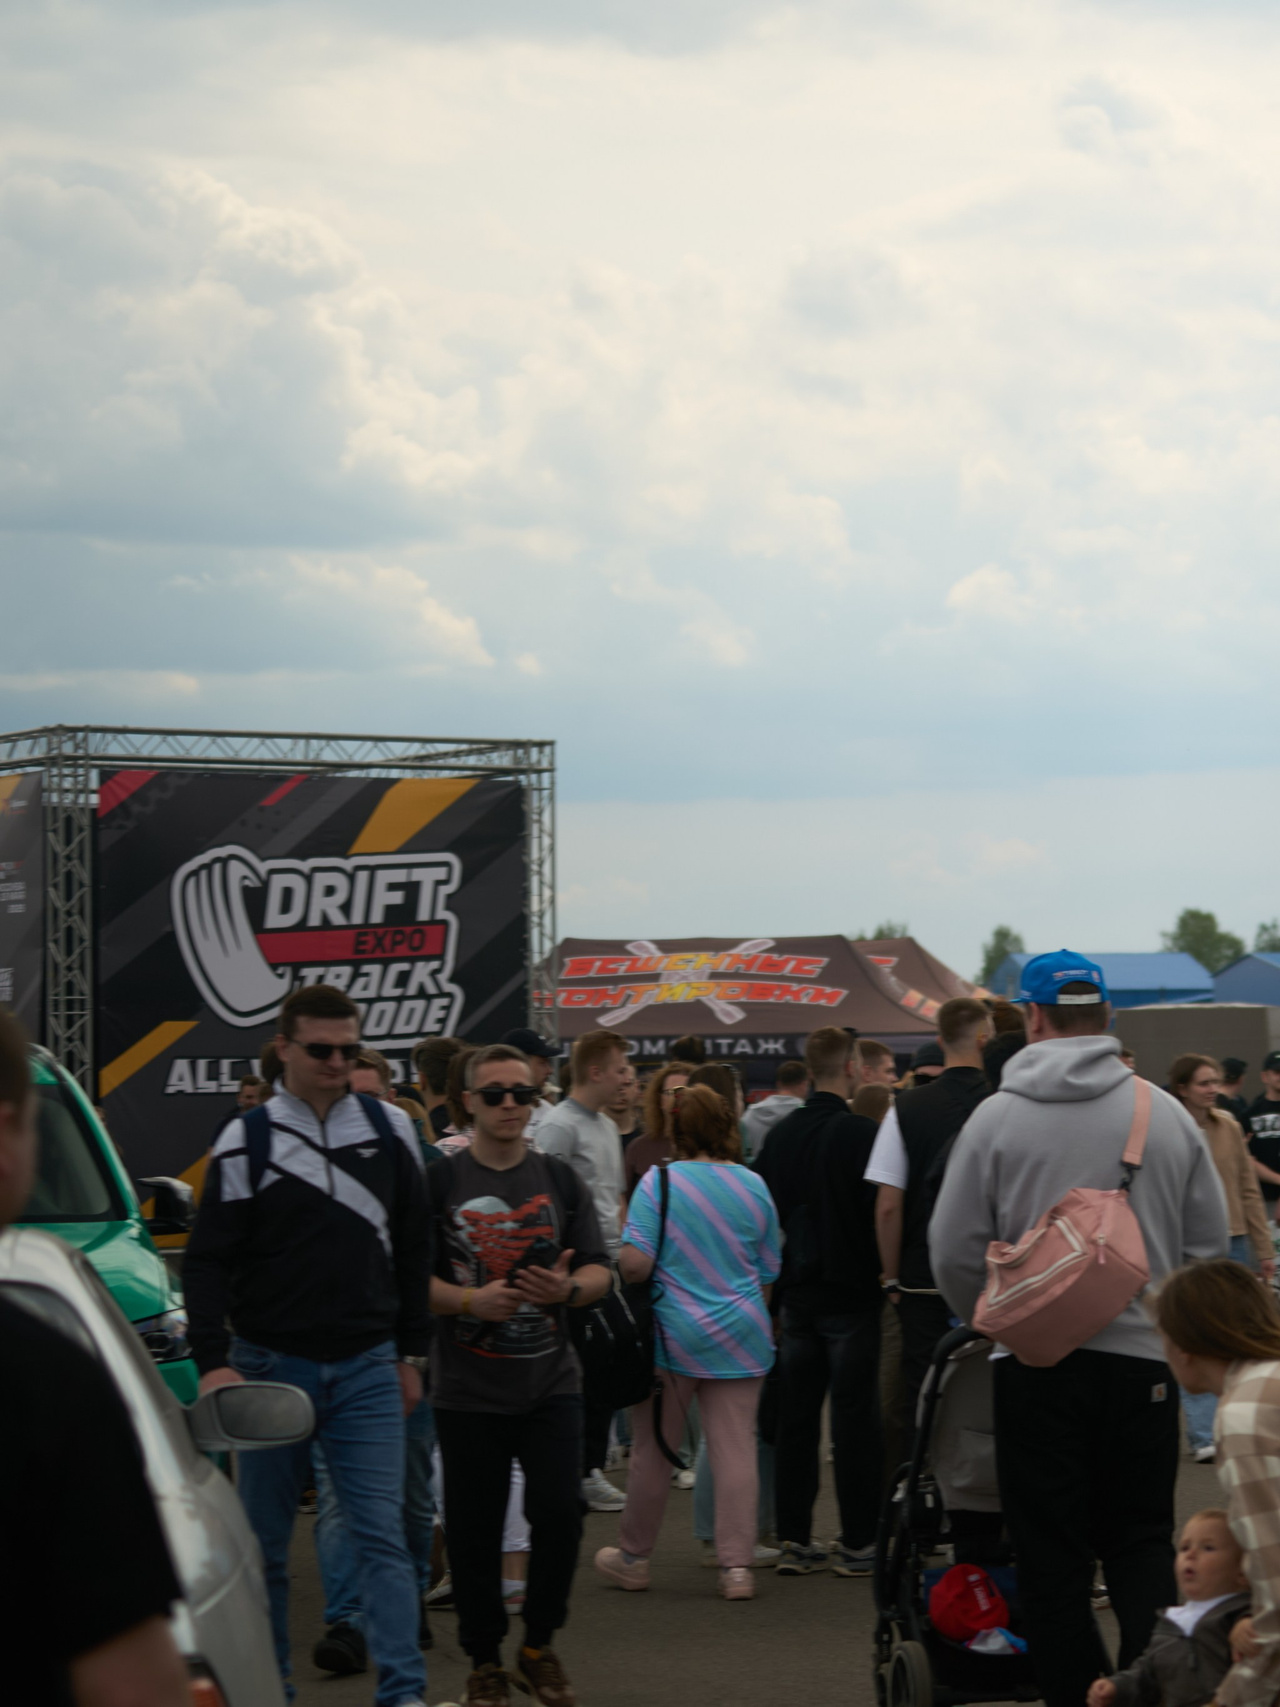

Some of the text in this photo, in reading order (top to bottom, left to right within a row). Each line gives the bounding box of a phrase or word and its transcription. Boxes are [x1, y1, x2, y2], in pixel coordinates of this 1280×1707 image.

[262, 866, 449, 929] DRIFT
[353, 928, 426, 956] EXPO
[558, 951, 830, 978] БЕШЕННЫЕ
[351, 997, 453, 1036] ODE
